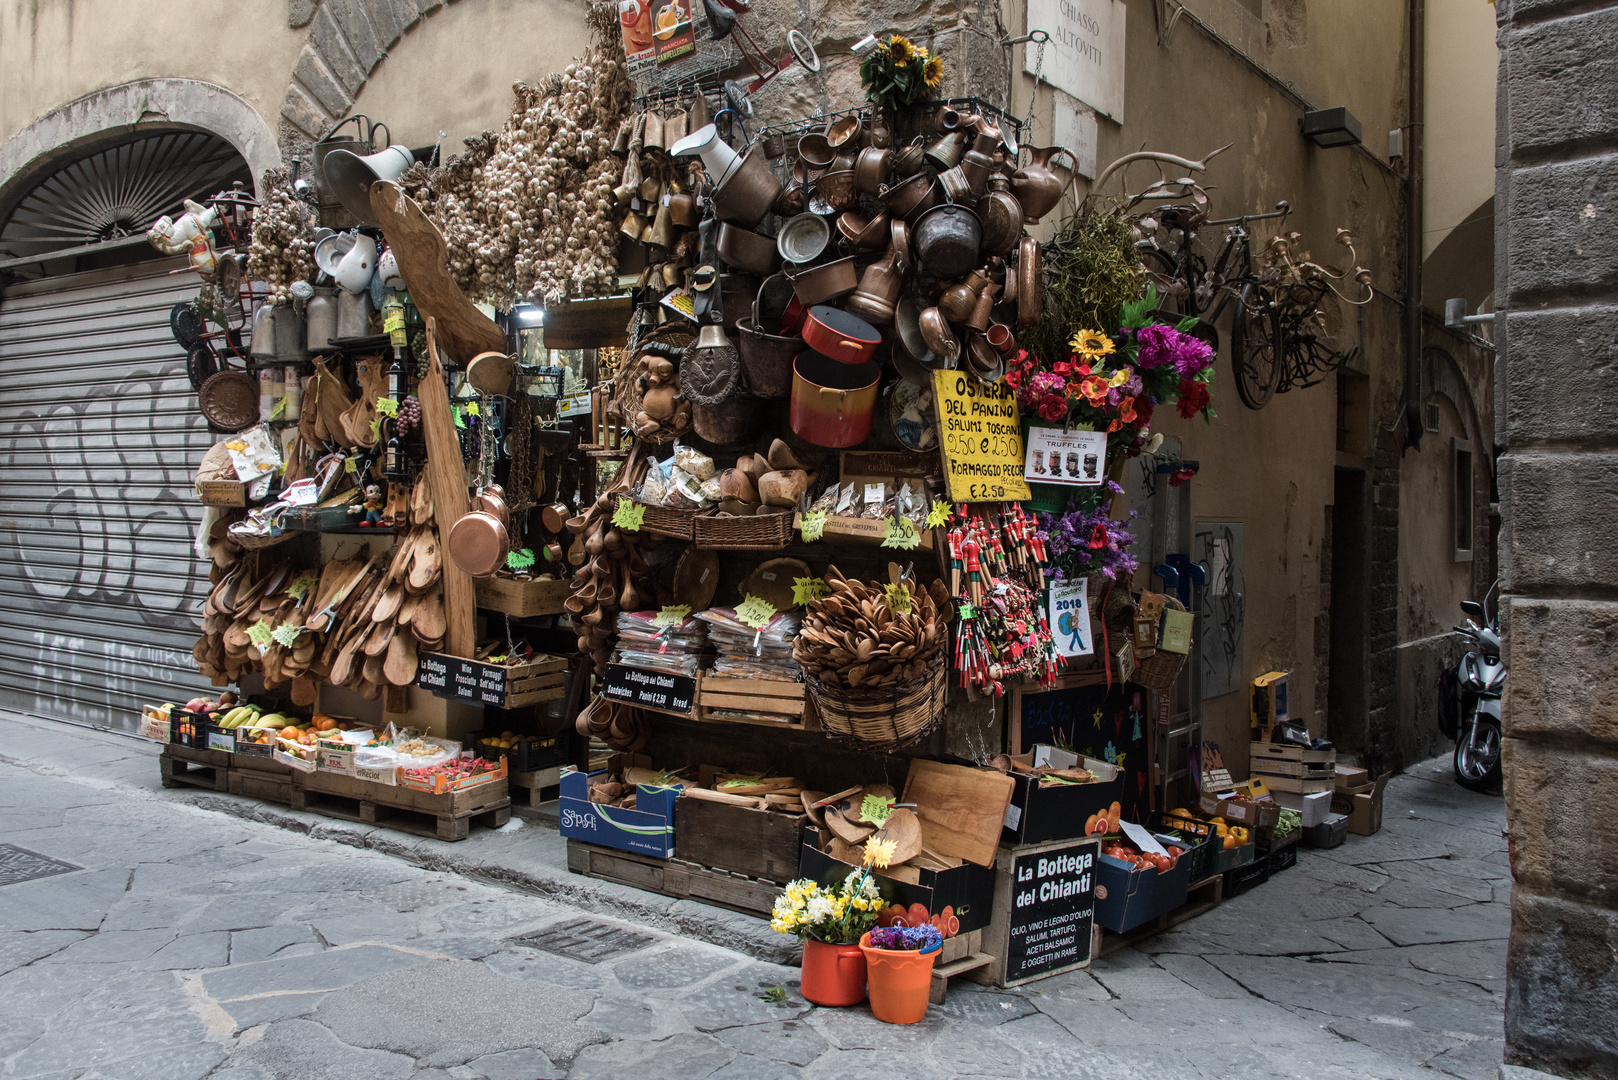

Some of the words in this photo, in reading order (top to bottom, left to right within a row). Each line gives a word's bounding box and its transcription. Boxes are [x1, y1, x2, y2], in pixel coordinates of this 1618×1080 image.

[1060, 0, 1100, 36] CHIASSO
[657, 42, 694, 63] SANPELLEGRINO
[660, 38, 688, 52] ARANCIATA
[1056, 25, 1102, 66] ALTOVITI
[956, 377, 1014, 400] OSTERIA
[945, 399, 966, 416] DEL
[971, 402, 1013, 418] PANINO
[948, 418, 982, 432] SALUMI
[986, 422, 1020, 436] TOSCANI
[1047, 441, 1087, 449] TRUFFLES
[951, 459, 1000, 476] FORMAGGIO
[852, 523, 878, 531] GREVEPESA
[1056, 598, 1082, 610] 2018
[421, 660, 426, 669] La
[427, 659, 446, 675] Bottega
[461, 663, 472, 674] Wine
[482, 667, 502, 681] Formaggi
[427, 673, 446, 686] Chianti
[625, 672, 631, 680] La
[631, 671, 649, 685] Bottega
[656, 676, 675, 688] Chianti
[458, 686, 473, 697] Salami
[482, 691, 499, 704] Insalate
[607, 684, 632, 697] Sandwiches
[639, 690, 653, 702] Panini
[673, 697, 688, 708] Bread
[1018, 866, 1034, 882] La
[1037, 853, 1093, 878] Bottega
[1016, 888, 1036, 908] del
[1040, 872, 1091, 902] Chianti
[1028, 921, 1043, 932] VINO
[1044, 920, 1048, 928] E
[1049, 914, 1069, 927] LEGNO
[1070, 908, 1092, 922] D'OLIVO
[1026, 931, 1048, 944] SALUMI,
[1050, 924, 1077, 937] TARTUFO,
[1026, 943, 1044, 956] ACETI
[1044, 935, 1075, 951] BALSAMICI
[1021, 960, 1027, 970] E
[1027, 953, 1054, 968] OGGETTI
[1054, 952, 1060, 960] IN
[1061, 946, 1077, 958] RAME
